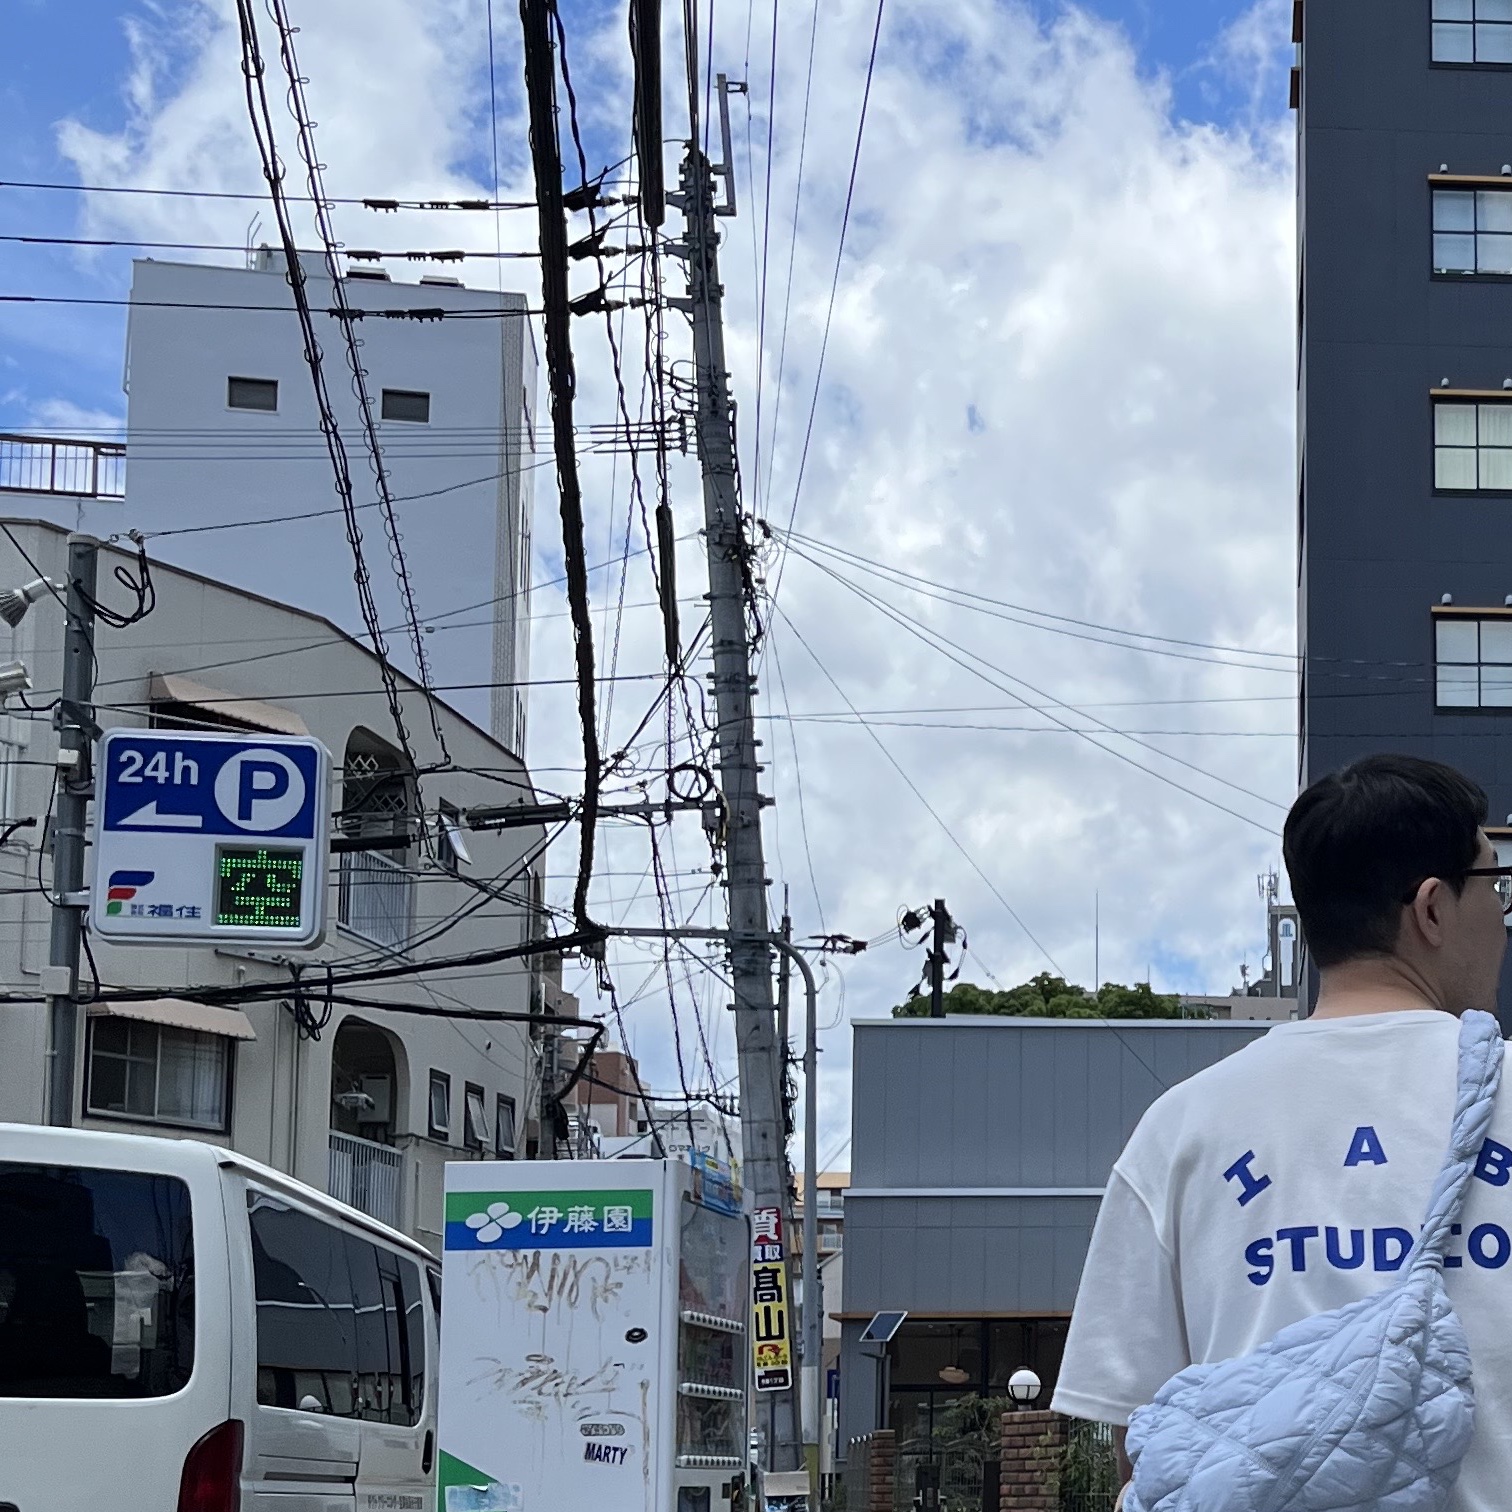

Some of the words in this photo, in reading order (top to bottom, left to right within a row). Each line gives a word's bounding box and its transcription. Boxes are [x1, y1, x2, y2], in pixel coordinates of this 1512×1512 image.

[118, 750, 199, 785] 24h
[238, 760, 290, 821] P
[218, 850, 303, 926] 空
[527, 1205, 633, 1234] 伊藤園
[753, 1208, 779, 1240] 質
[584, 1442, 628, 1465] MARTY
